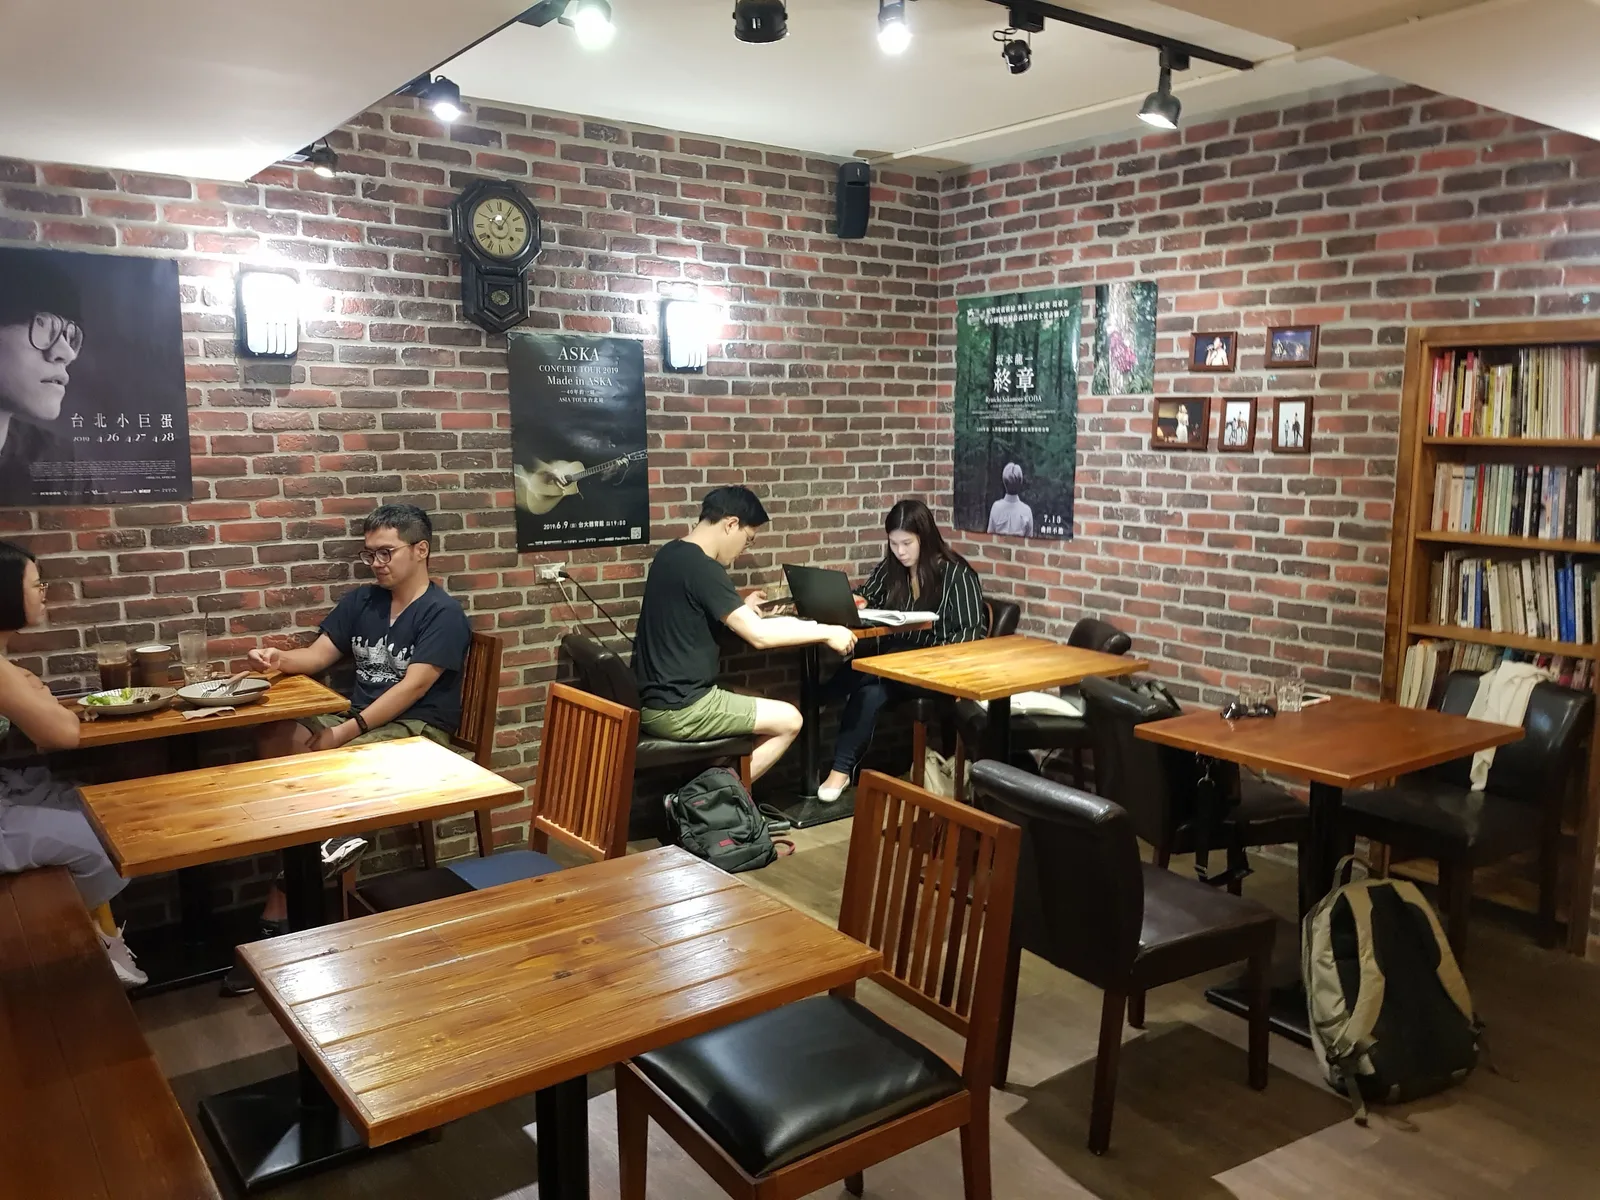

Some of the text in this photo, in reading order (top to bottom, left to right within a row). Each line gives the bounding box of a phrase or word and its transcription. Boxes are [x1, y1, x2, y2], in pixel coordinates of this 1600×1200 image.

[558, 347, 600, 361] ASKA
[995, 353, 1034, 366] 坂本龍一
[538, 364, 619, 374] CONCERT TOUR 2019
[547, 375, 613, 387] Made in ASKA
[993, 367, 1035, 393] 終章
[70, 412, 173, 428] 台北小巨蛋
